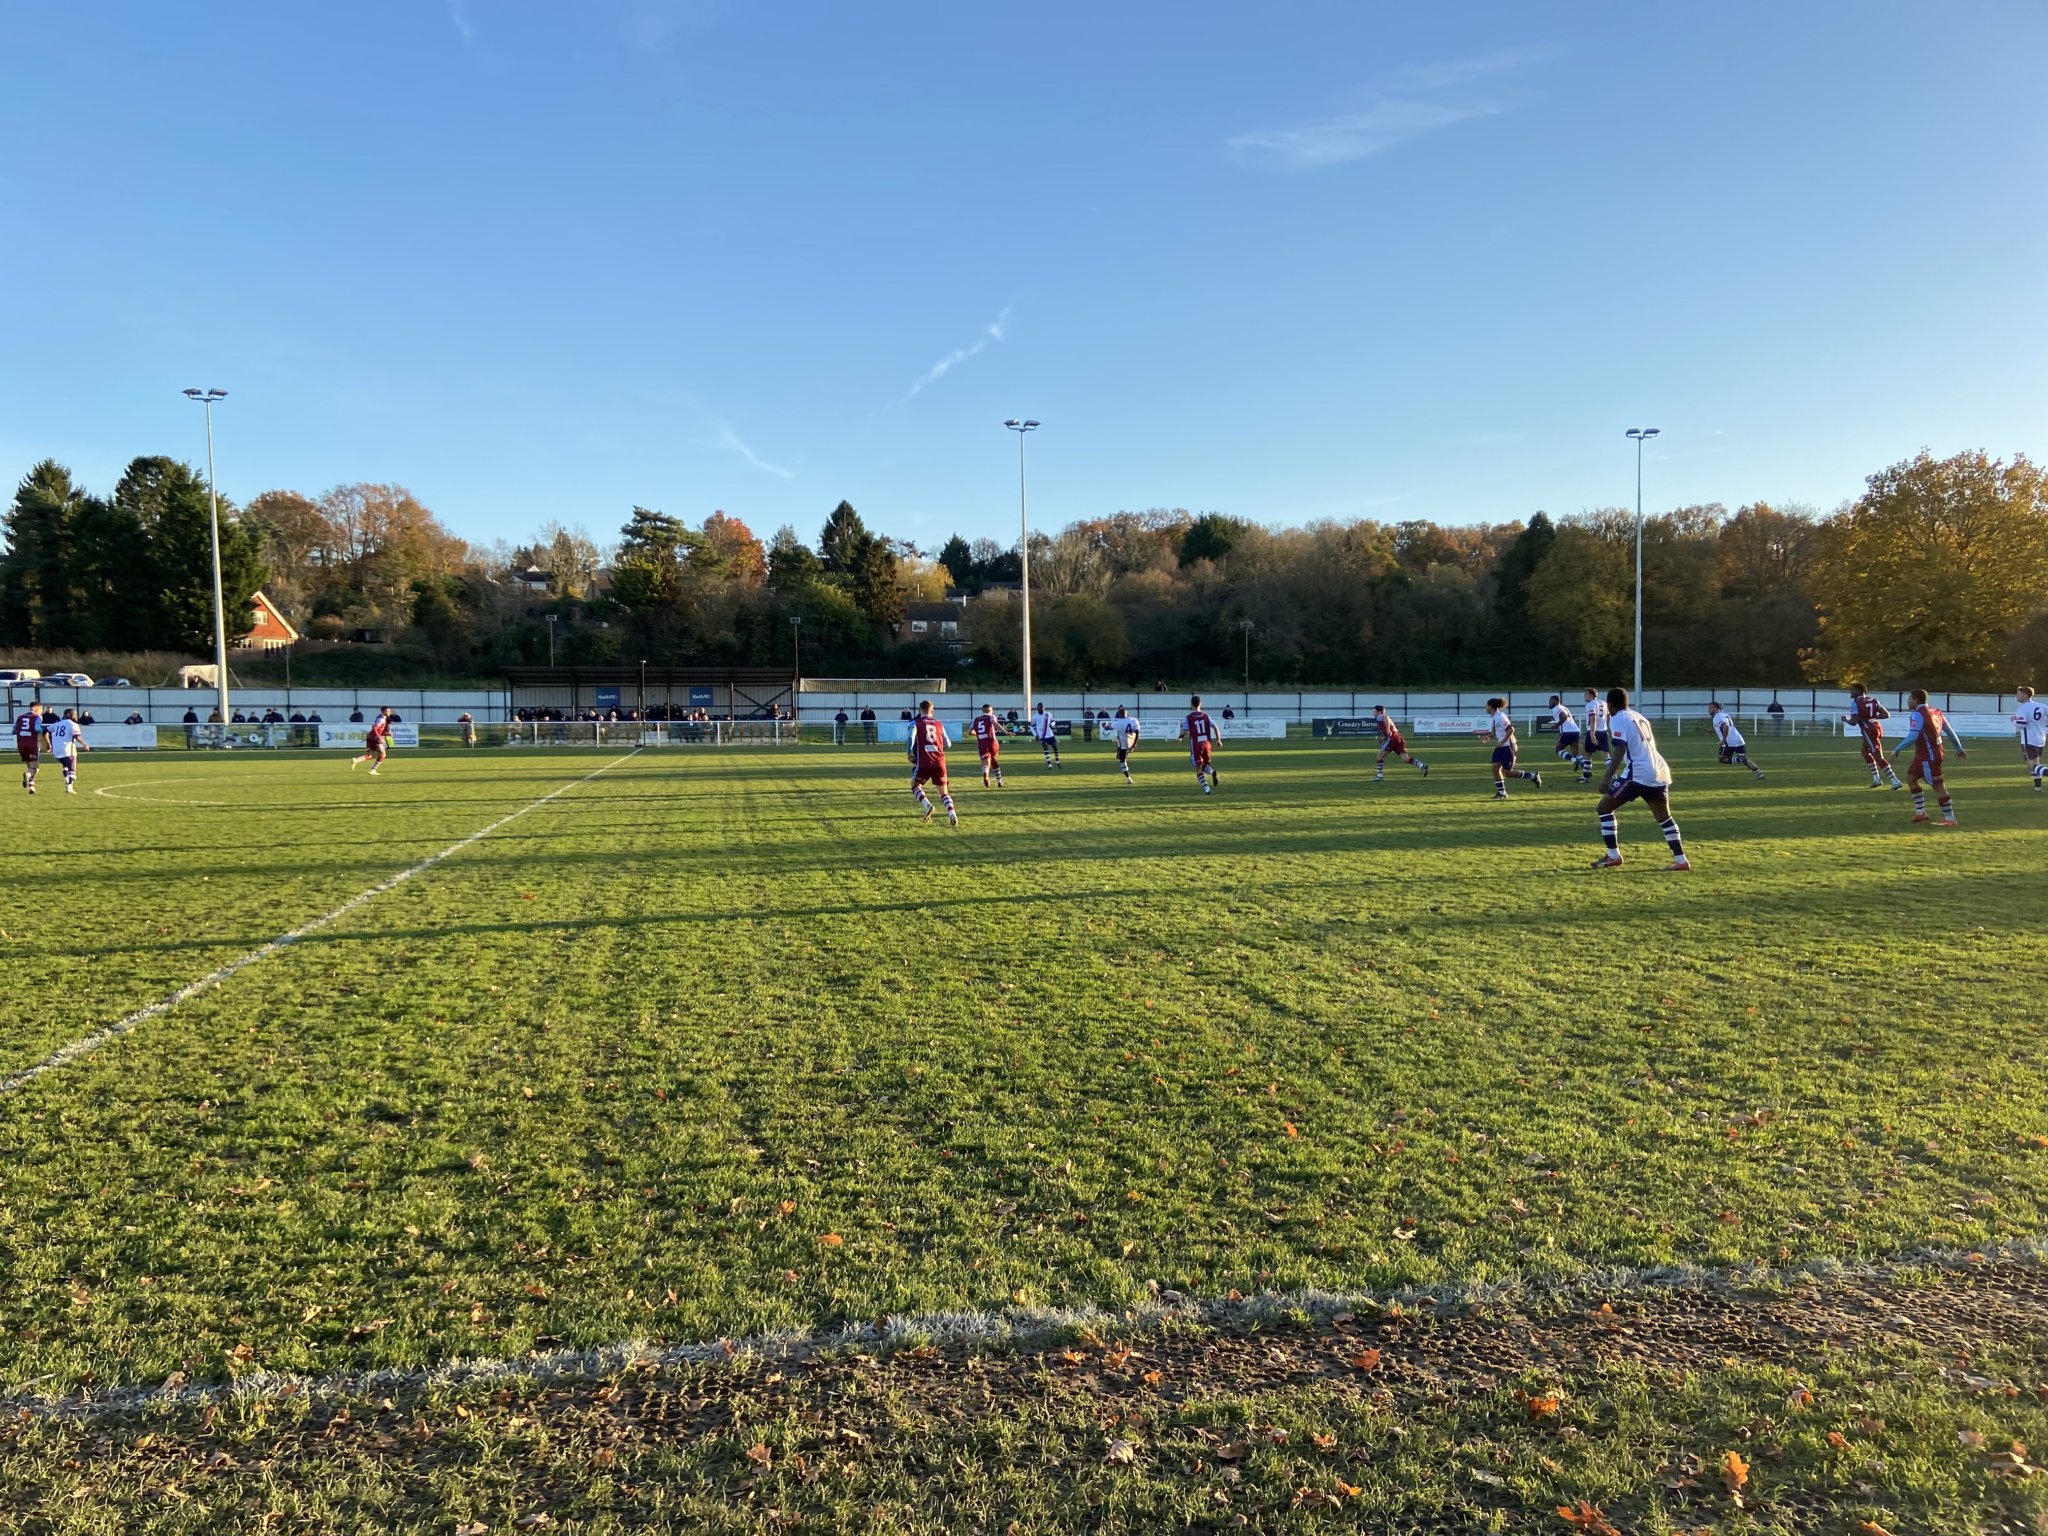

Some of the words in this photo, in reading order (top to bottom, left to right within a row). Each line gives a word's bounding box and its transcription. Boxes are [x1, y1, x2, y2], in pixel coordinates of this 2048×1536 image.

[1866, 703, 1873, 717] 7
[2033, 707, 2042, 721] 6
[21, 718, 30, 730] 3
[978, 720, 986, 733] 5
[1125, 723, 1133, 733] 4
[1194, 719, 1206, 734] 11
[1338, 720, 1361, 728] Country
[1632, 719, 1652, 742] 10
[55, 726, 66, 738] 18
[926, 724, 937, 742] 8
